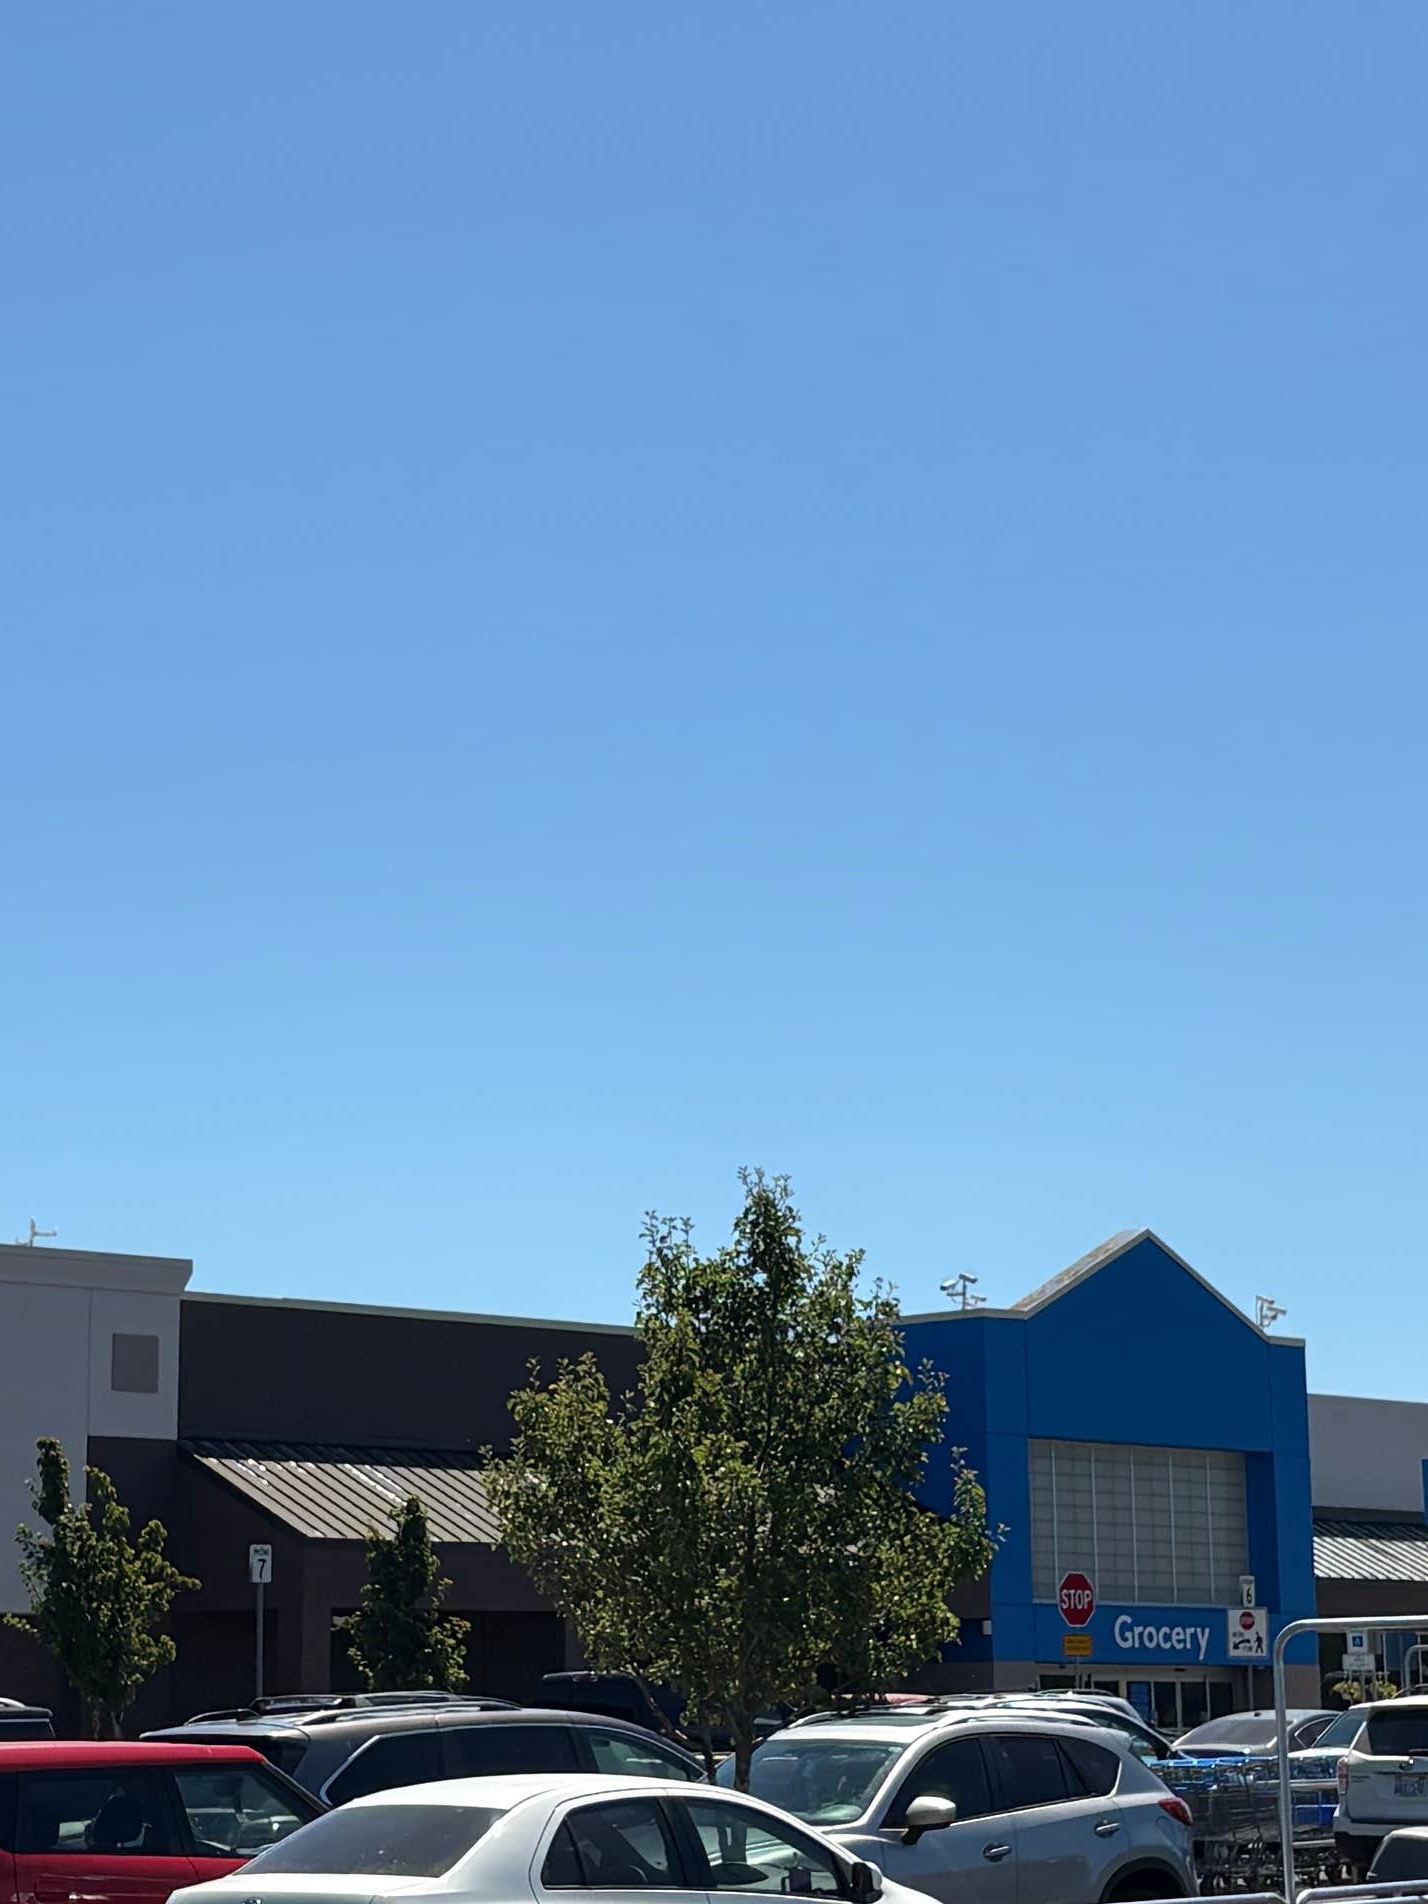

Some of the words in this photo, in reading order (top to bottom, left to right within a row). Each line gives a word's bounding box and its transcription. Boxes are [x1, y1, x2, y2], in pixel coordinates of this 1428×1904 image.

[257, 1558, 267, 1580] 7
[1061, 1589, 1092, 1610] STOP
[1246, 1585, 1253, 1604] 6
[1114, 1614, 1210, 1661] Grocery
